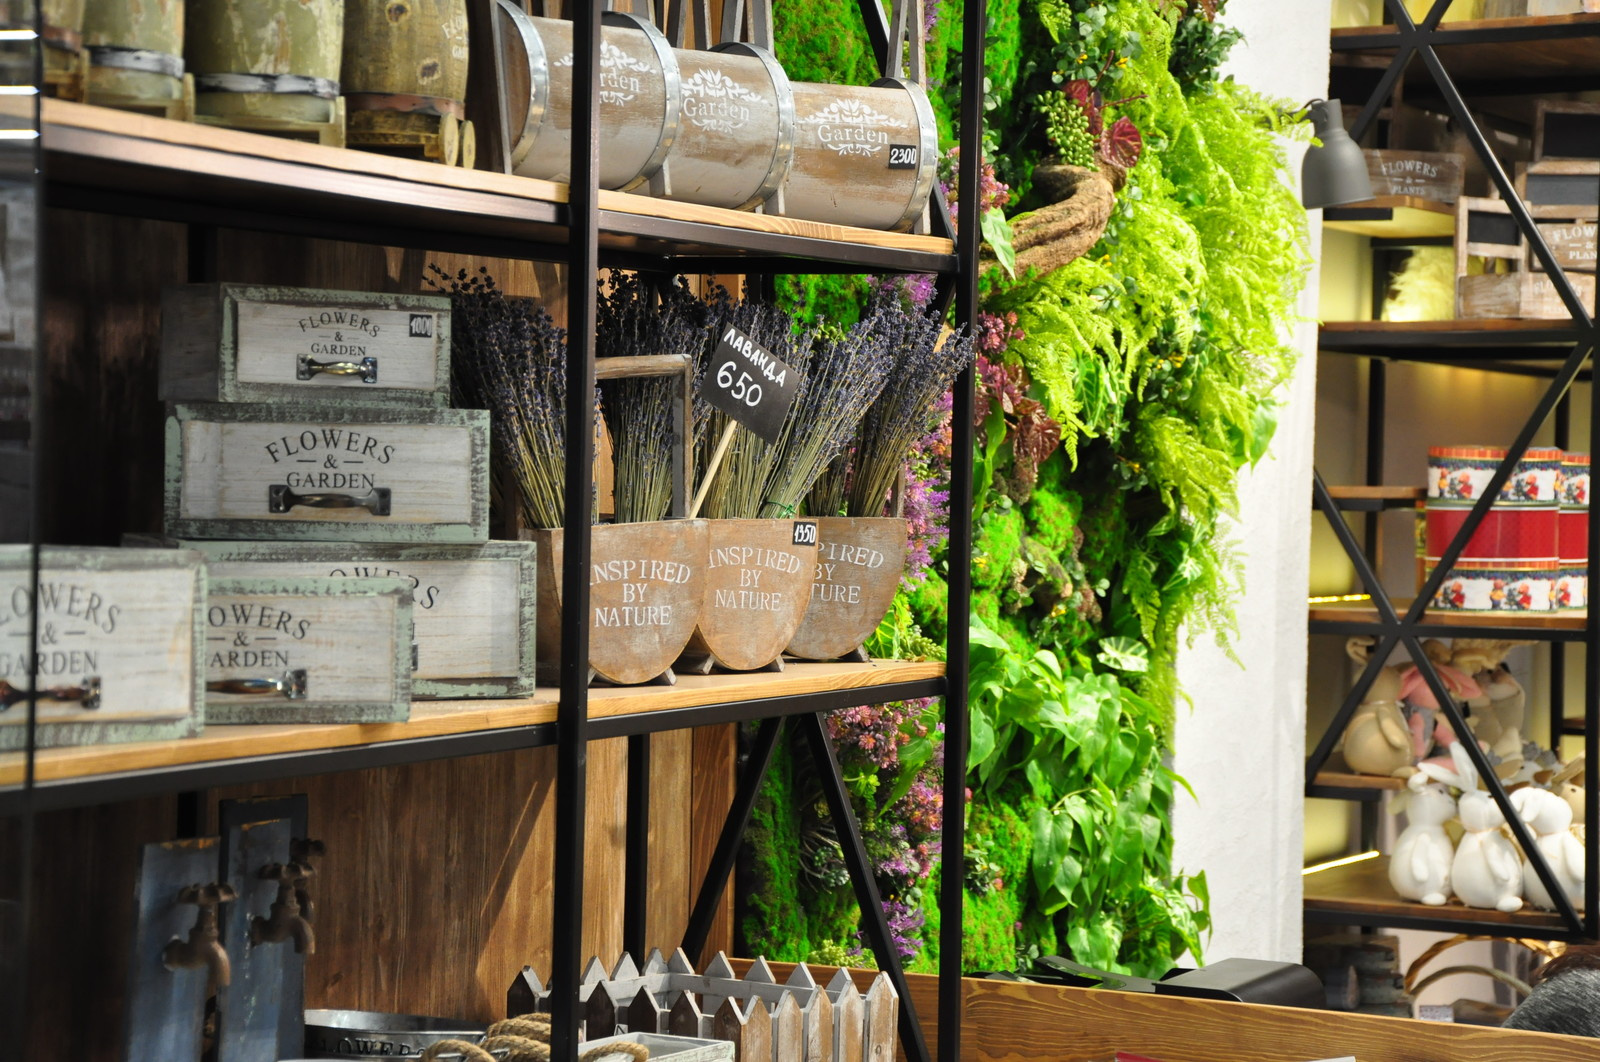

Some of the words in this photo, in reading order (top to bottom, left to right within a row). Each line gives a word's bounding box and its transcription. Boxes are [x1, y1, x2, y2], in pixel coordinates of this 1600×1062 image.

[599, 67, 641, 92] rden
[683, 97, 750, 121] Garden
[817, 123, 888, 145] Garden
[889, 147, 917, 165] 2300
[1382, 160, 1438, 178] FLOWERS
[1392, 185, 1425, 195] PLANTS
[1552, 225, 1596, 242] FLOW
[1568, 250, 1597, 260] PLAN
[1585, 241, 1594, 249] &
[298, 311, 381, 338] FLOWERS
[334, 331, 343, 342] &
[310, 342, 367, 356] GARDEN
[723, 328, 787, 388] ЛАВАНДА
[716, 361, 763, 407] 650
[264, 428, 396, 465] FLOWERS
[323, 453, 339, 470] &
[286, 471, 376, 489] GARDEN
[794, 524, 817, 544] 1350
[708, 546, 801, 574] INSPIRED
[589, 559, 692, 586] NSPIRED
[740, 568, 762, 588] BY
[814, 563, 836, 581] BY
[622, 583, 648, 603] BY
[714, 589, 782, 612] NATURE
[811, 583, 861, 605] TURE
[207, 603, 312, 640] OWERS
[594, 605, 673, 628] NATURE
[41, 621, 57, 645] &
[233, 631, 249, 647] &
[210, 651, 290, 668] ARDEN
